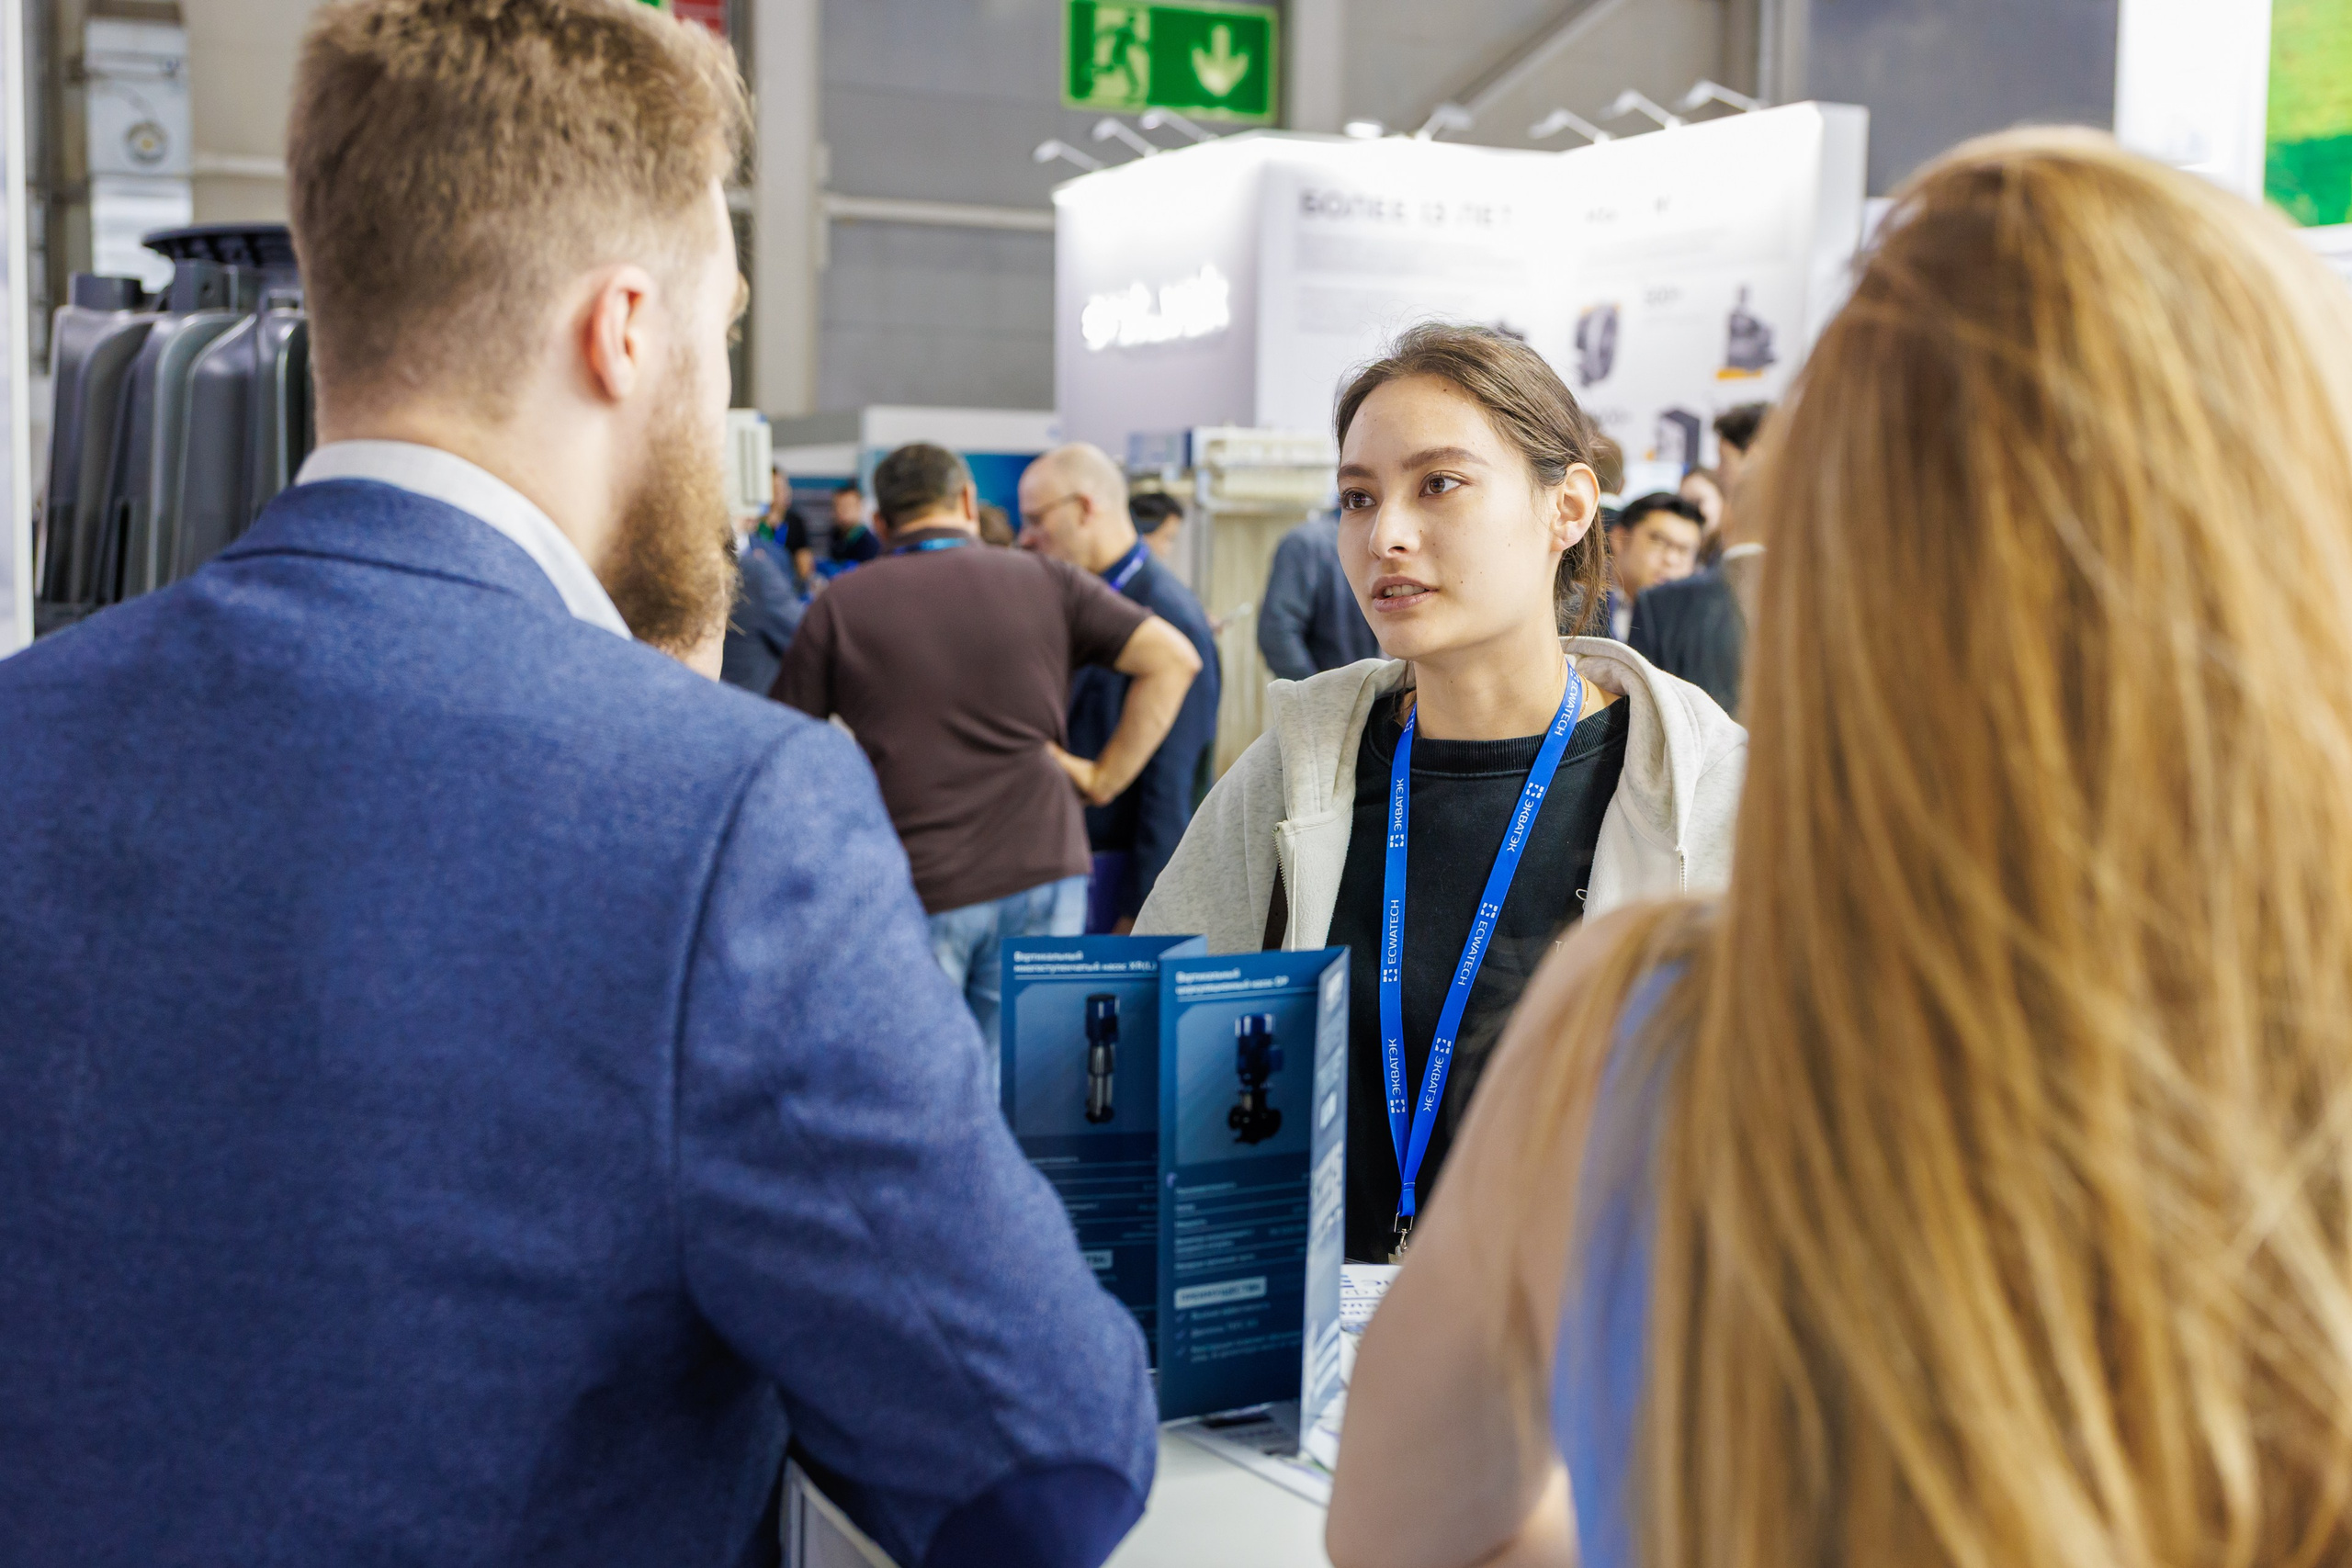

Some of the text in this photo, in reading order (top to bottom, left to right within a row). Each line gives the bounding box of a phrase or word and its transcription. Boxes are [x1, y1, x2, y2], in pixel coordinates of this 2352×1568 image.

[1555, 680, 1579, 737] ECWATECH
[1393, 778, 1404, 831] ЭКВАТЭК
[1507, 800, 1534, 852] ЭКВАТЭК
[1387, 899, 1399, 964] ECWATECH
[1458, 920, 1488, 986] ECWATECH
[1388, 1038, 1401, 1095] ЭКВАТЭК
[1423, 1055, 1444, 1112] ЭКВАТЭК
